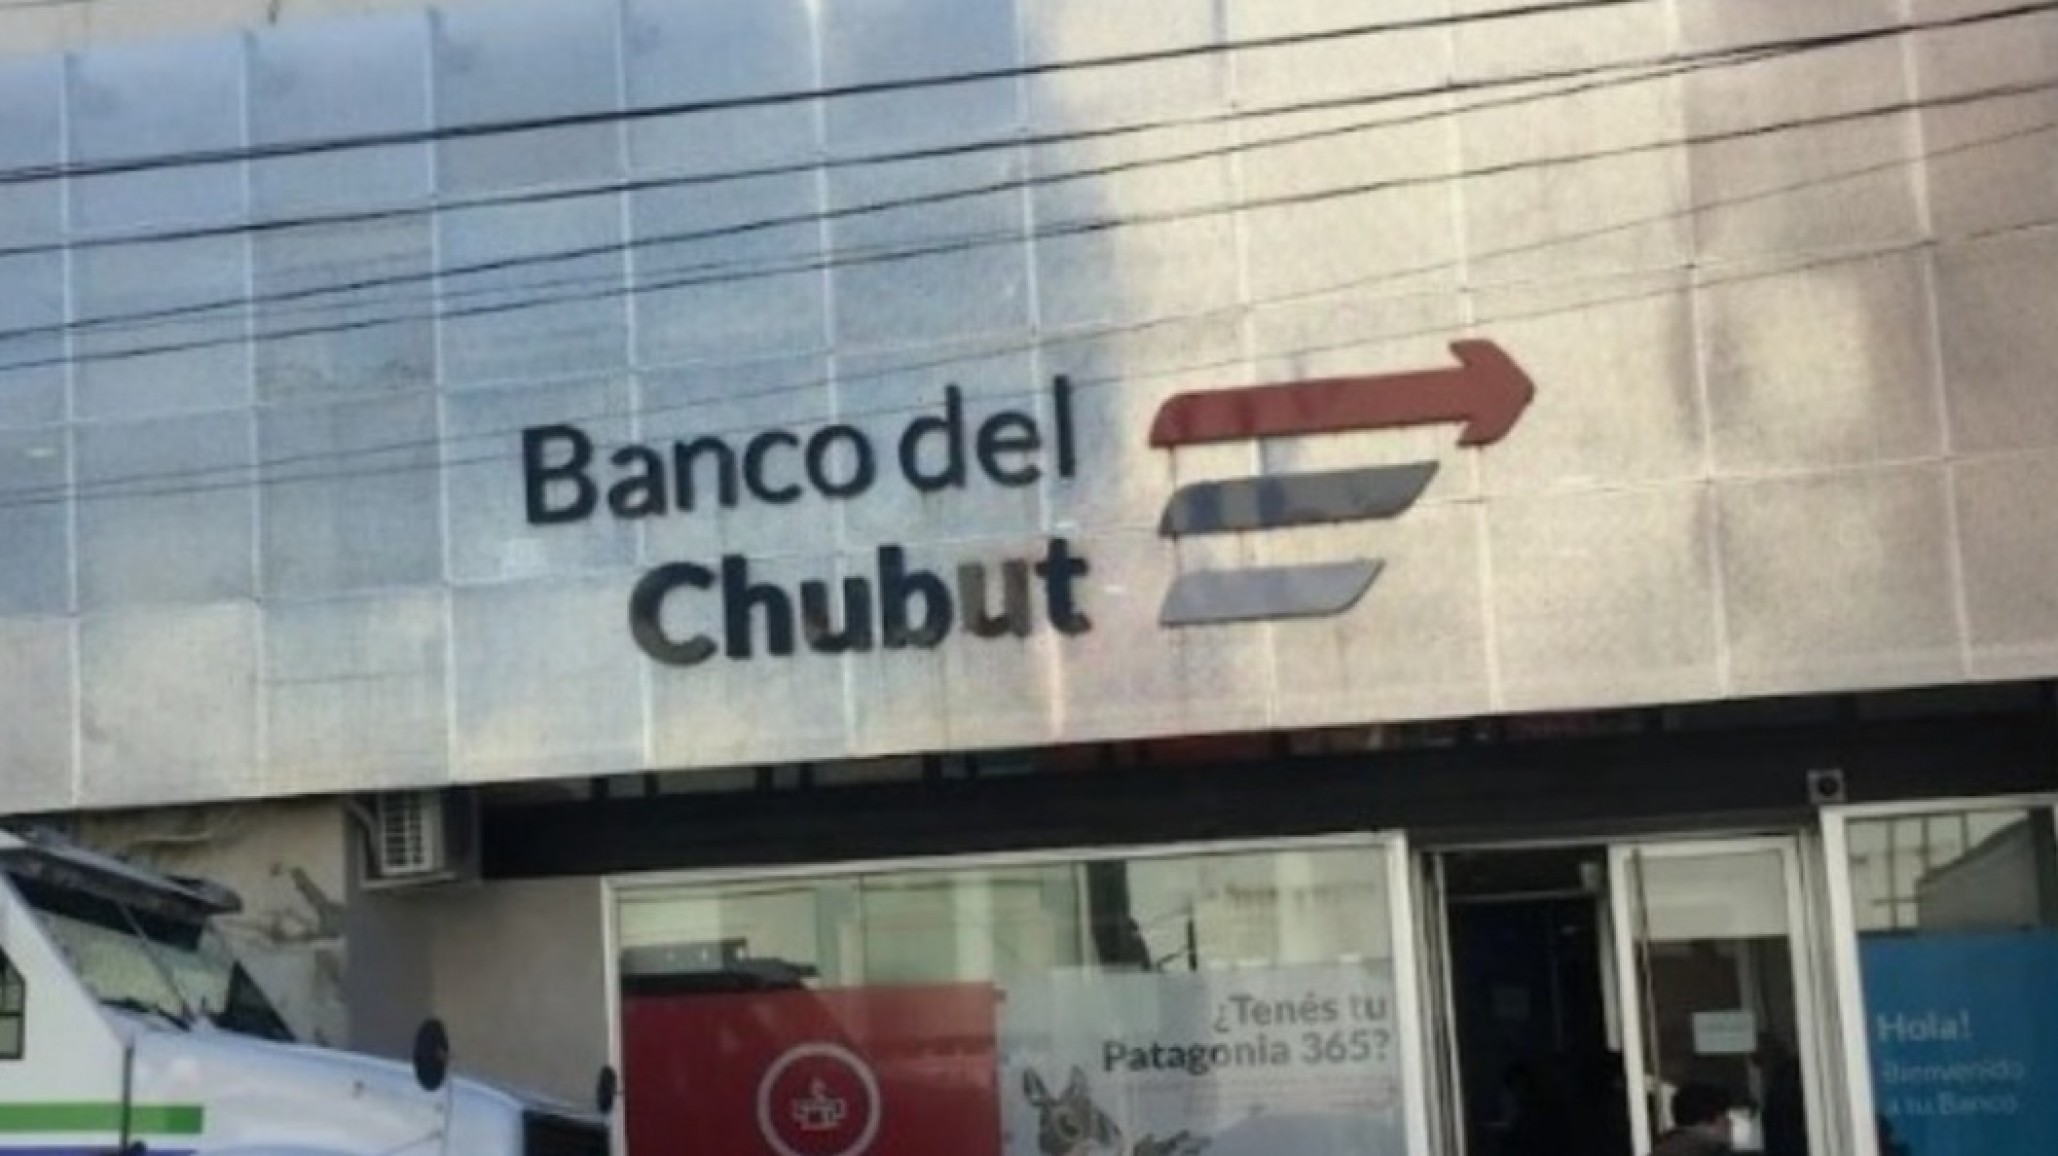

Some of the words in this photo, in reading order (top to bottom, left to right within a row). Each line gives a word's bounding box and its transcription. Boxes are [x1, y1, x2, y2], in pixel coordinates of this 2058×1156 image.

[522, 423, 876, 525] Banco
[898, 374, 1076, 494] del
[628, 537, 1092, 667] Chubut
[1213, 990, 1339, 1033] ¿Tenés
[1349, 992, 1388, 1022] tu
[1876, 1008, 1972, 1043] Hola!
[1101, 1033, 1291, 1076] Patagonia
[1301, 1027, 1391, 1064] 365?
